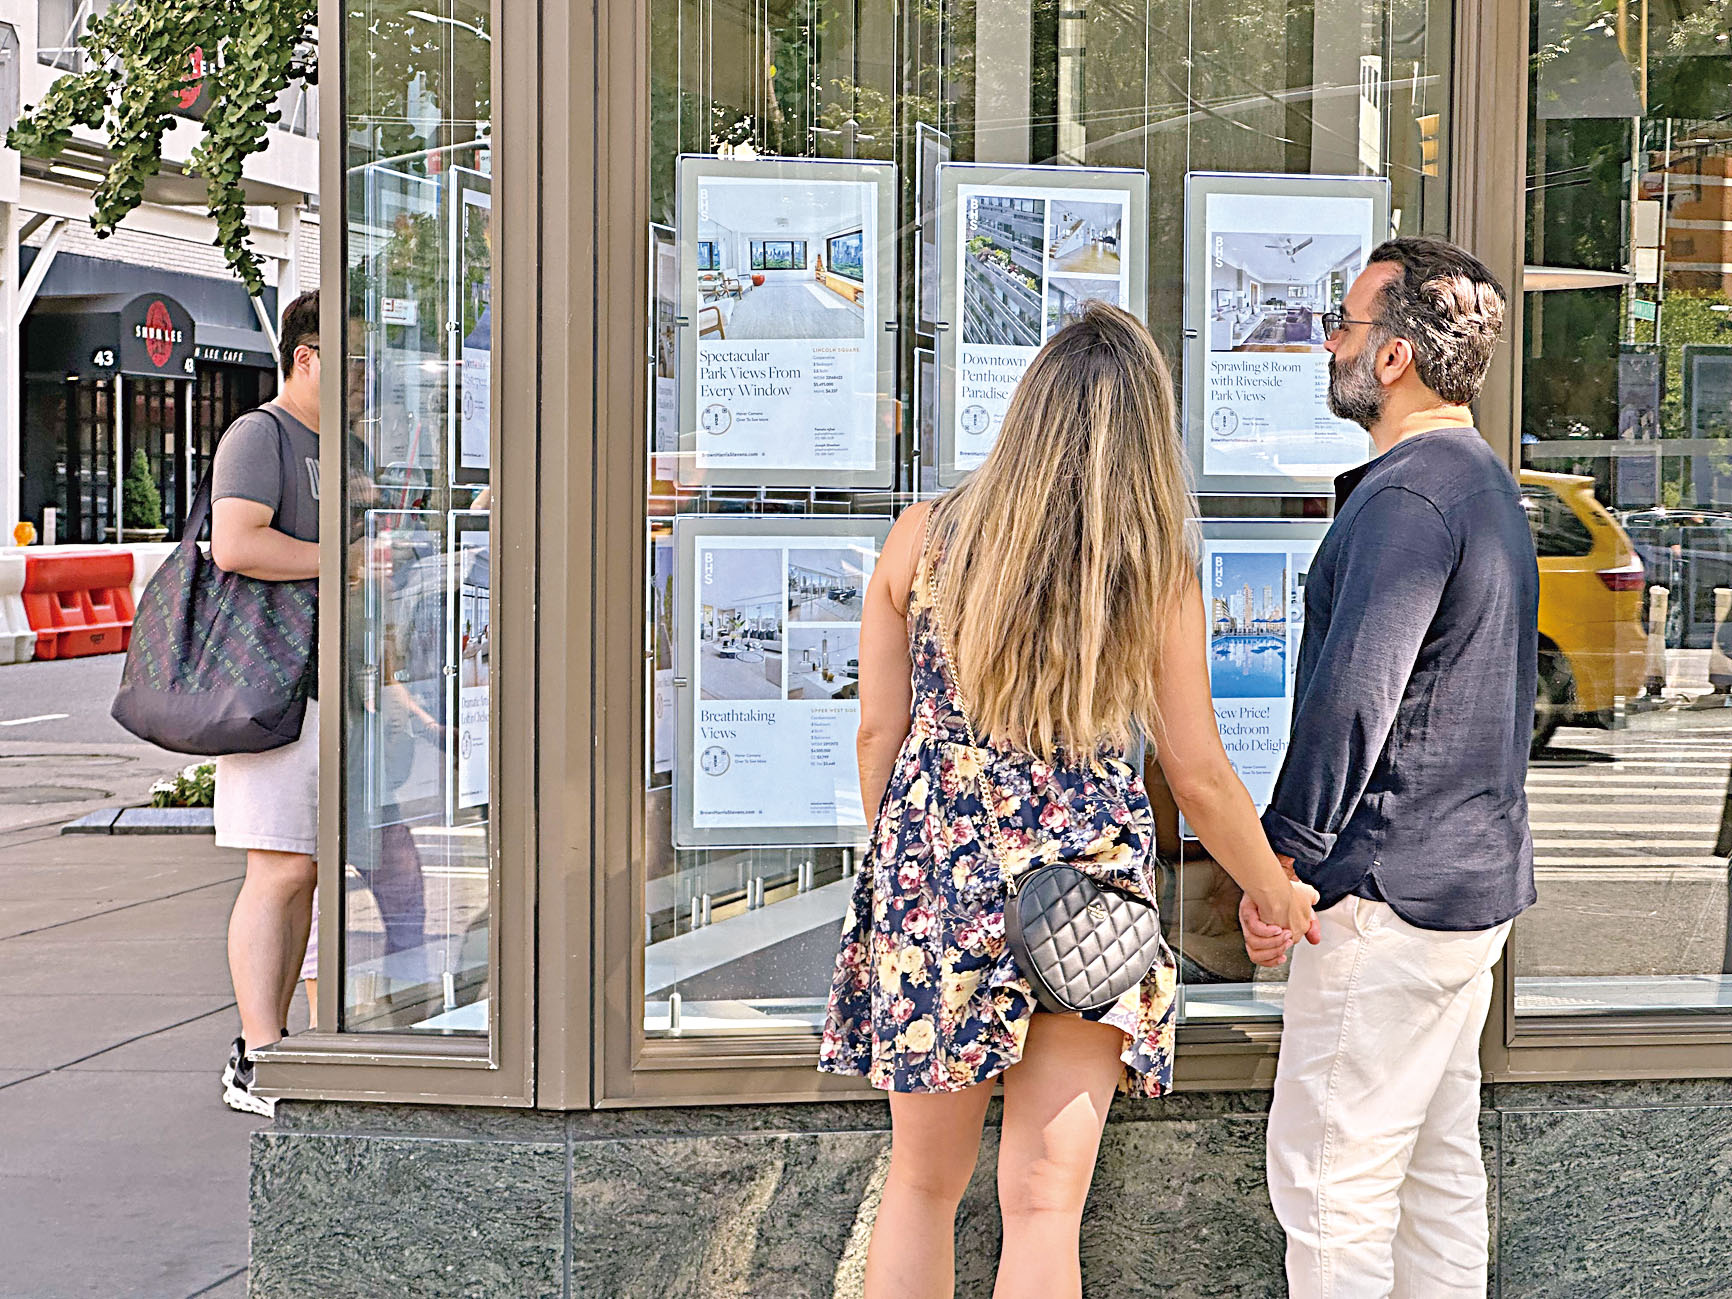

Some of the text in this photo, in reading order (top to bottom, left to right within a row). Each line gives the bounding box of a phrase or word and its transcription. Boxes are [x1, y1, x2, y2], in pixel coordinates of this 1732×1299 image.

[701, 189, 709, 221] BHS
[970, 198, 979, 230] BHS
[1215, 236, 1224, 268] BHS
[135, 325, 182, 343] SHUN LEE
[93, 350, 114, 367] 43
[204, 348, 220, 360] LEE
[223, 350, 244, 363] CAFE
[700, 349, 770, 366] Spectacular
[963, 352, 1027, 367] Downtown
[184, 357, 194, 374] 43
[701, 367, 727, 379] Park
[730, 367, 766, 379] Views
[769, 366, 801, 379] From
[1210, 360, 1301, 375] Sprawling 8 Room
[962, 369, 1022, 383] Penthouse
[1210, 375, 1283, 387] with Riverside
[701, 383, 791, 401] Every Window
[962, 385, 1009, 400] Paradise
[1211, 389, 1266, 401] Park Views
[704, 552, 713, 585] BHS
[1215, 556, 1223, 587] BHS
[701, 709, 776, 725] Breathtaking
[1213, 707, 1270, 719] New Price!
[701, 727, 737, 739] Views
[1219, 723, 1270, 735] Bedroom
[1223, 739, 1289, 754] ndo Deligh
